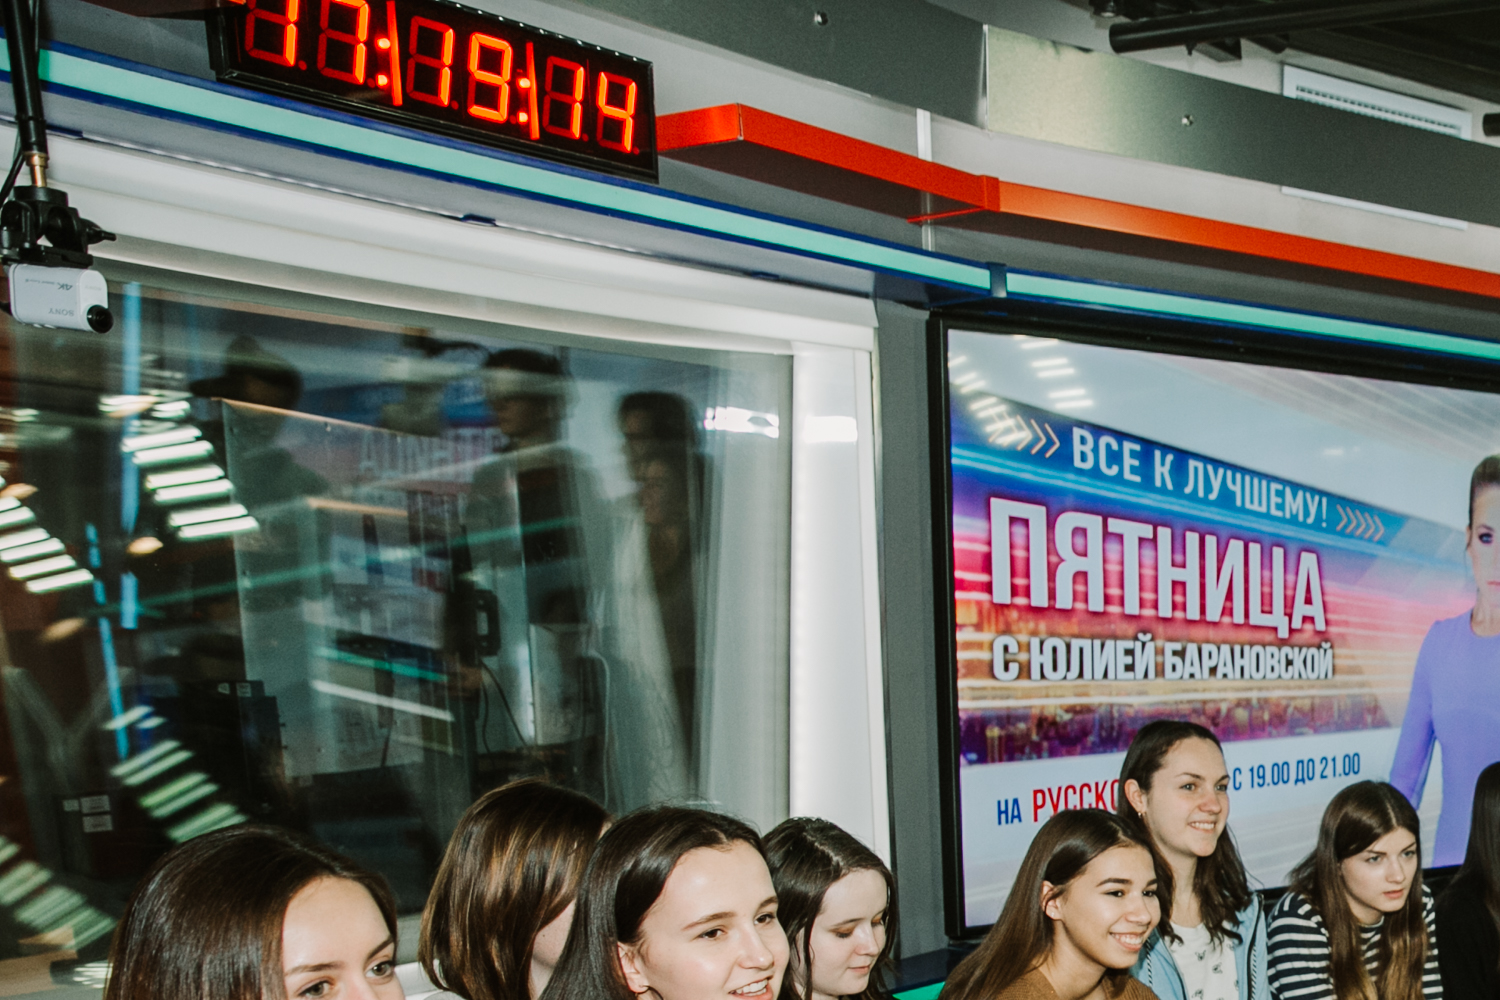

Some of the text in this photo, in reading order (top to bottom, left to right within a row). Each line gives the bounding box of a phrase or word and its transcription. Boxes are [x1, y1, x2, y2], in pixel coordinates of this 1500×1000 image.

[48, 307, 75, 317] SONY
[1072, 426, 1328, 528] ВСЕ К ЛУЧШЕМУ!
[990, 497, 1326, 639] ПЯТНИЦА
[992, 632, 1334, 682] С ЮЛИЕЙ БАРАНОВСКОЙ
[997, 797, 1022, 827] НА
[1232, 767, 1242, 792] С
[1249, 761, 1291, 790] 19.00
[1294, 757, 1315, 786] ДО
[1319, 751, 1361, 780] 21.00
